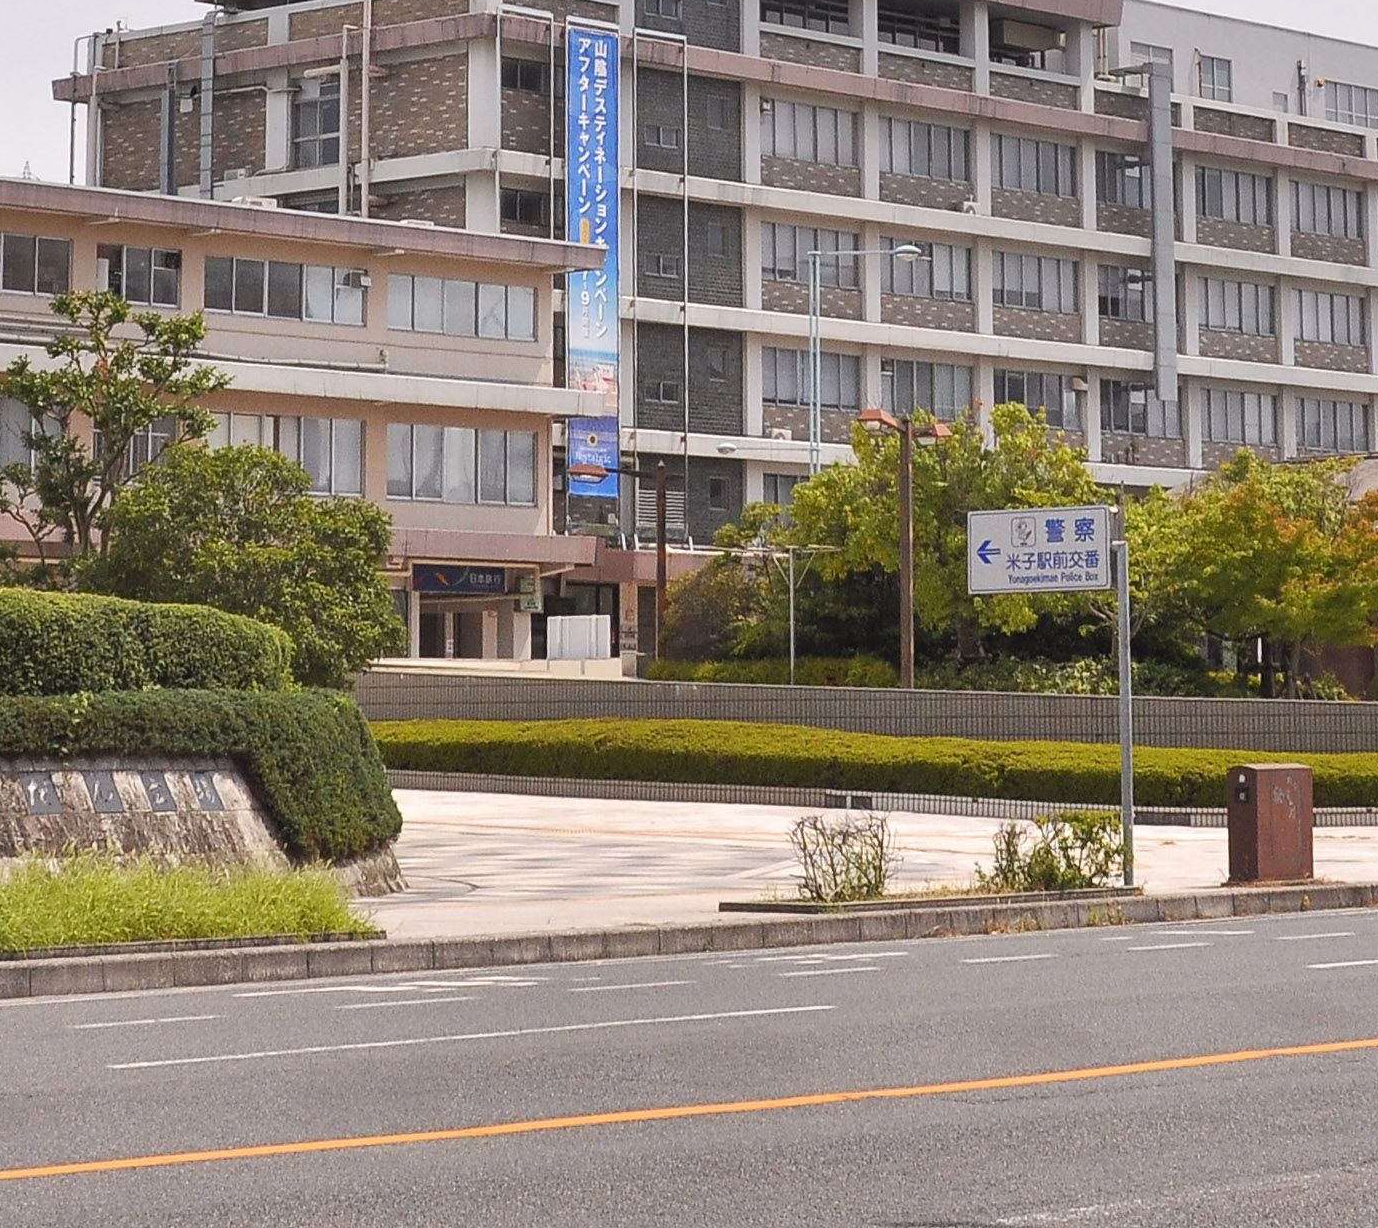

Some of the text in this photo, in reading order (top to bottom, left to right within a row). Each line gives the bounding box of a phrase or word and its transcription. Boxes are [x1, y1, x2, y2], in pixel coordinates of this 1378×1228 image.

[578, 37, 592, 214] アフターキャンペーン
[594, 39, 608, 338] 山陰デスティネーションキンペーン
[1045, 517, 1095, 543] 警察
[1006, 550, 1099, 571] 米子駅前交番
[1008, 571, 1098, 586] Yonagoekimae Police Box
